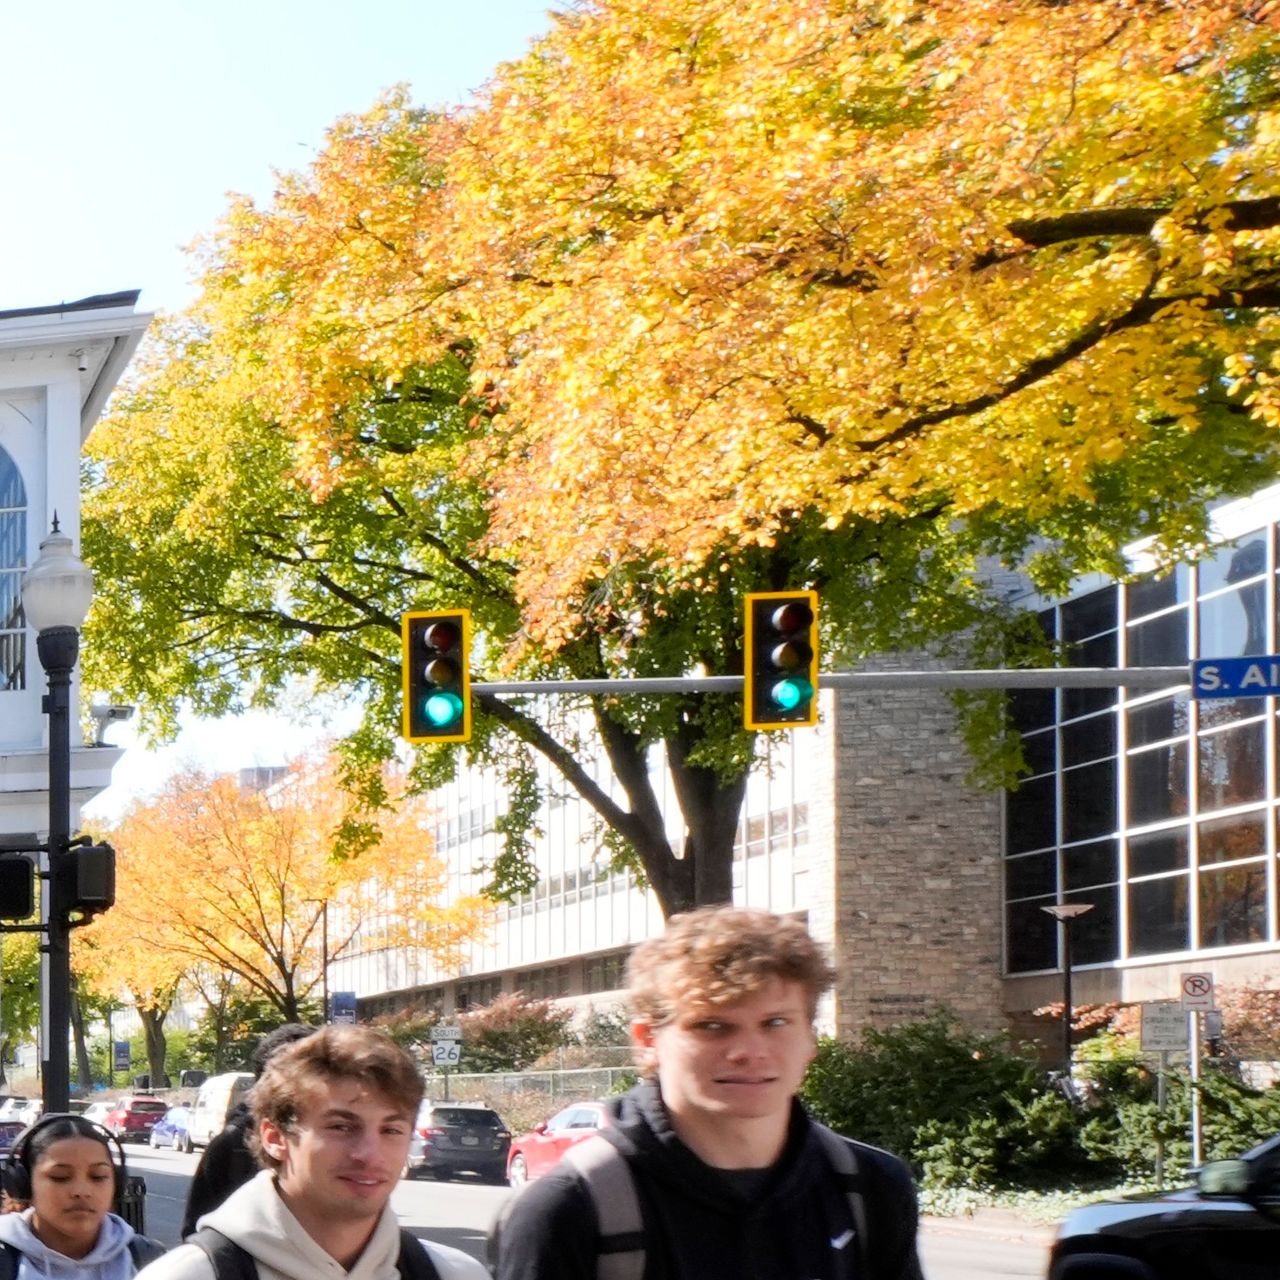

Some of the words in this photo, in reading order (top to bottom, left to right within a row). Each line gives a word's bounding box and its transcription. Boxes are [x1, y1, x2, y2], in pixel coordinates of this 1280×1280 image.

[1199, 665, 1230, 691] S.
[1238, 663, 1278, 689] Al
[434, 1029, 459, 1037] SOUTH
[435, 1046, 458, 1060] 26
